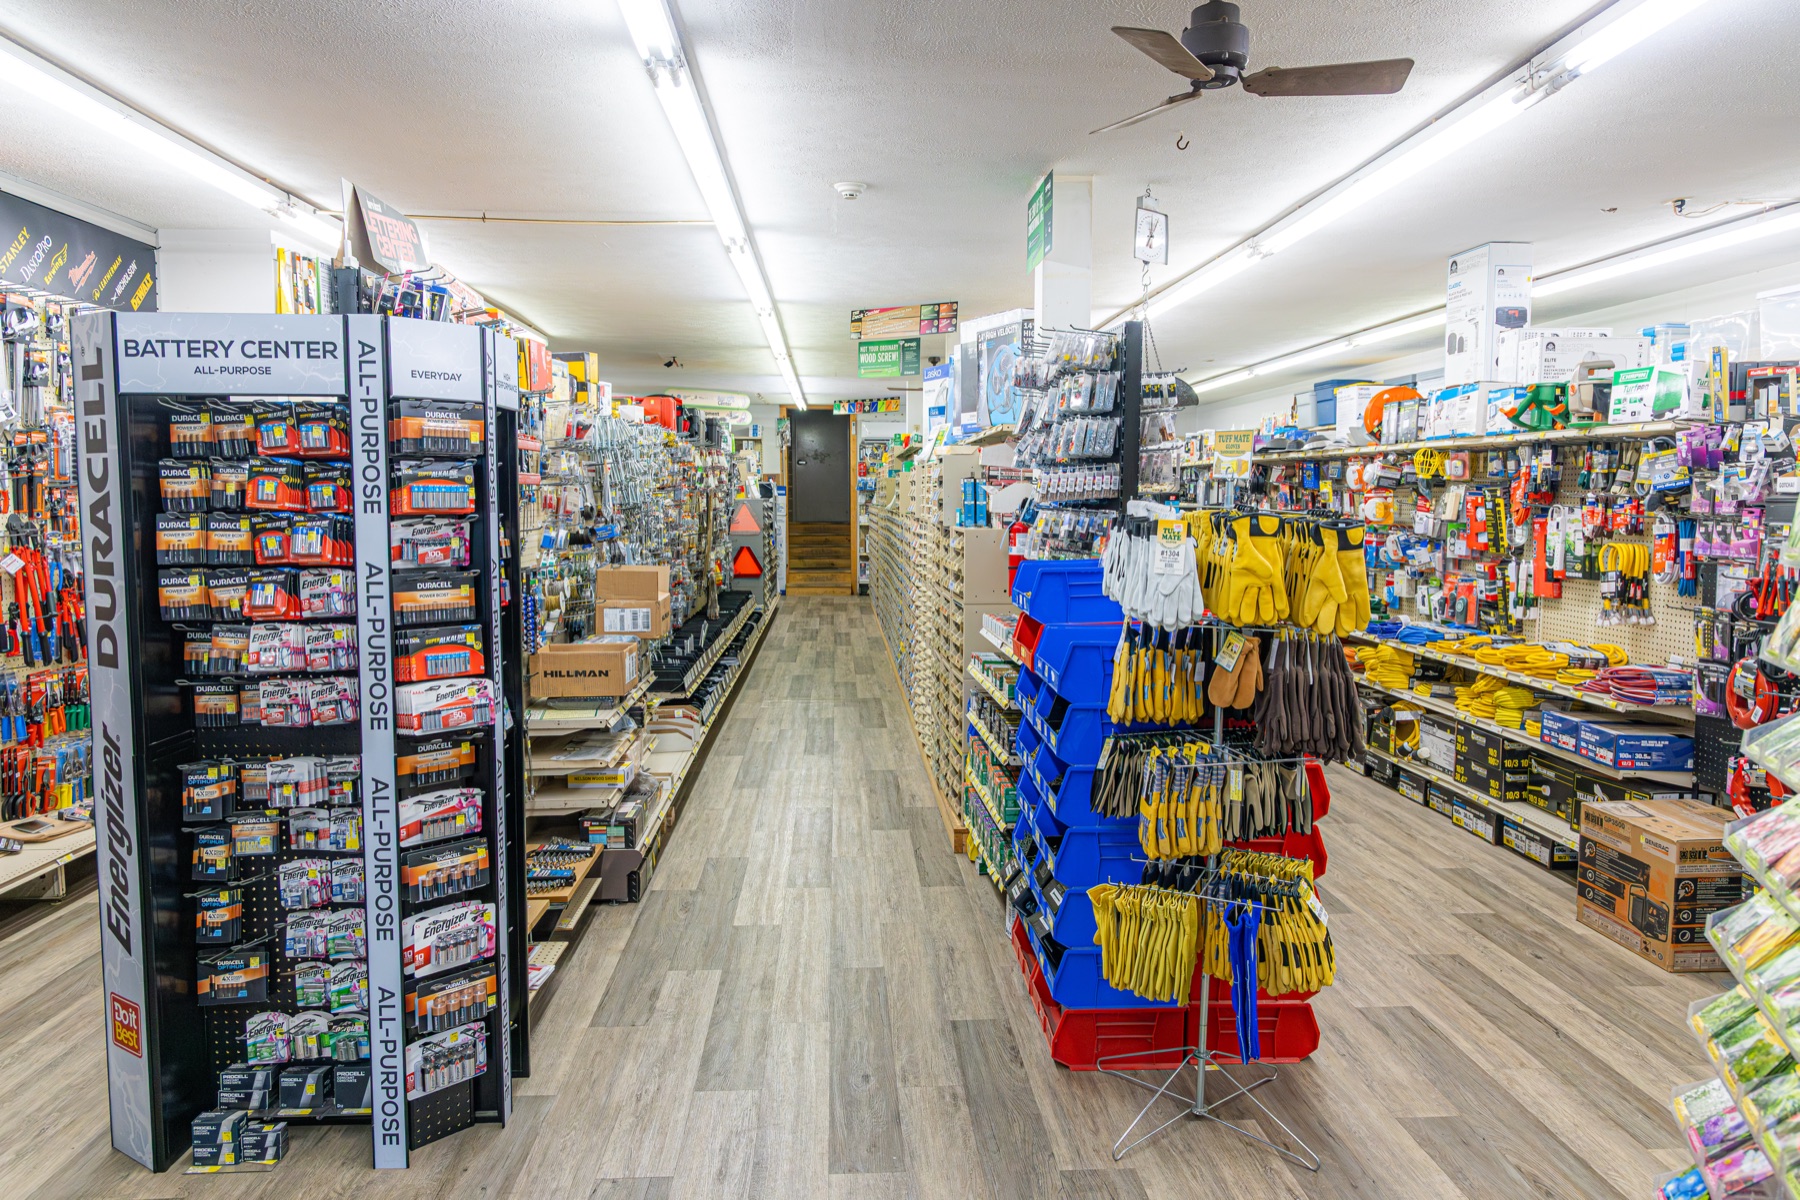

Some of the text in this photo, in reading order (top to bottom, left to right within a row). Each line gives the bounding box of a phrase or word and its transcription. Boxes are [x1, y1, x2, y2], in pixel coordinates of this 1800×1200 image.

[361, 208, 419, 245] LETTERING
[0, 226, 30, 274] STANLEY
[375, 234, 417, 263] CENTER
[98, 254, 123, 292] LEATHERMAN
[114, 259, 139, 298] NICHOLSON
[997, 324, 1019, 337] VELOCITY
[124, 339, 339, 360] BATTERY CENTER
[860, 353, 877, 363] WOOD
[877, 351, 899, 362] SCREW!
[193, 365, 272, 376] ALL-PURPOSE
[410, 370, 462, 382] EVERYDAY
[924, 368, 942, 380] Lasko
[171, 413, 202, 422] DURACE
[425, 411, 461, 420] DURACELL
[357, 339, 383, 515] ALL-PURPOSE
[1218, 434, 1251, 444] TUFF MATE
[161, 469, 191, 477] DURACE
[81, 346, 119, 670] DURACELL
[159, 521, 190, 529] DURACE
[210, 521, 240, 529] DURACE
[411, 523, 444, 537] Energizer
[1161, 534, 1182, 542] MATE
[1160, 549, 1180, 557] #1304
[209, 576, 248, 587] DURACELL
[417, 581, 453, 590] DURACELL
[439, 633, 467, 643] ALKALINE
[365, 561, 389, 731] ALL-PURPOSE
[543, 669, 610, 679] HILLMAN
[436, 686, 467, 702] Energizer
[418, 741, 453, 752] DURACELL
[1504, 759, 1519, 768] 10/3
[1505, 791, 1520, 800] 10/3
[1603, 815, 1626, 830] GP3500
[101, 720, 133, 957] Energizer
[1644, 837, 1670, 853] GENERAC
[370, 776, 395, 942] ALL-PURPOSE
[289, 917, 326, 930] Energizer
[328, 921, 362, 933] Energizer
[423, 909, 469, 940] Energizer
[414, 952, 425, 962] 10
[115, 1000, 137, 1028] Do it
[248, 1020, 286, 1037] Energizer
[115, 1024, 139, 1049] Best
[377, 986, 401, 1147] ALL-PURPOSE
[406, 1073, 415, 1083] 10
